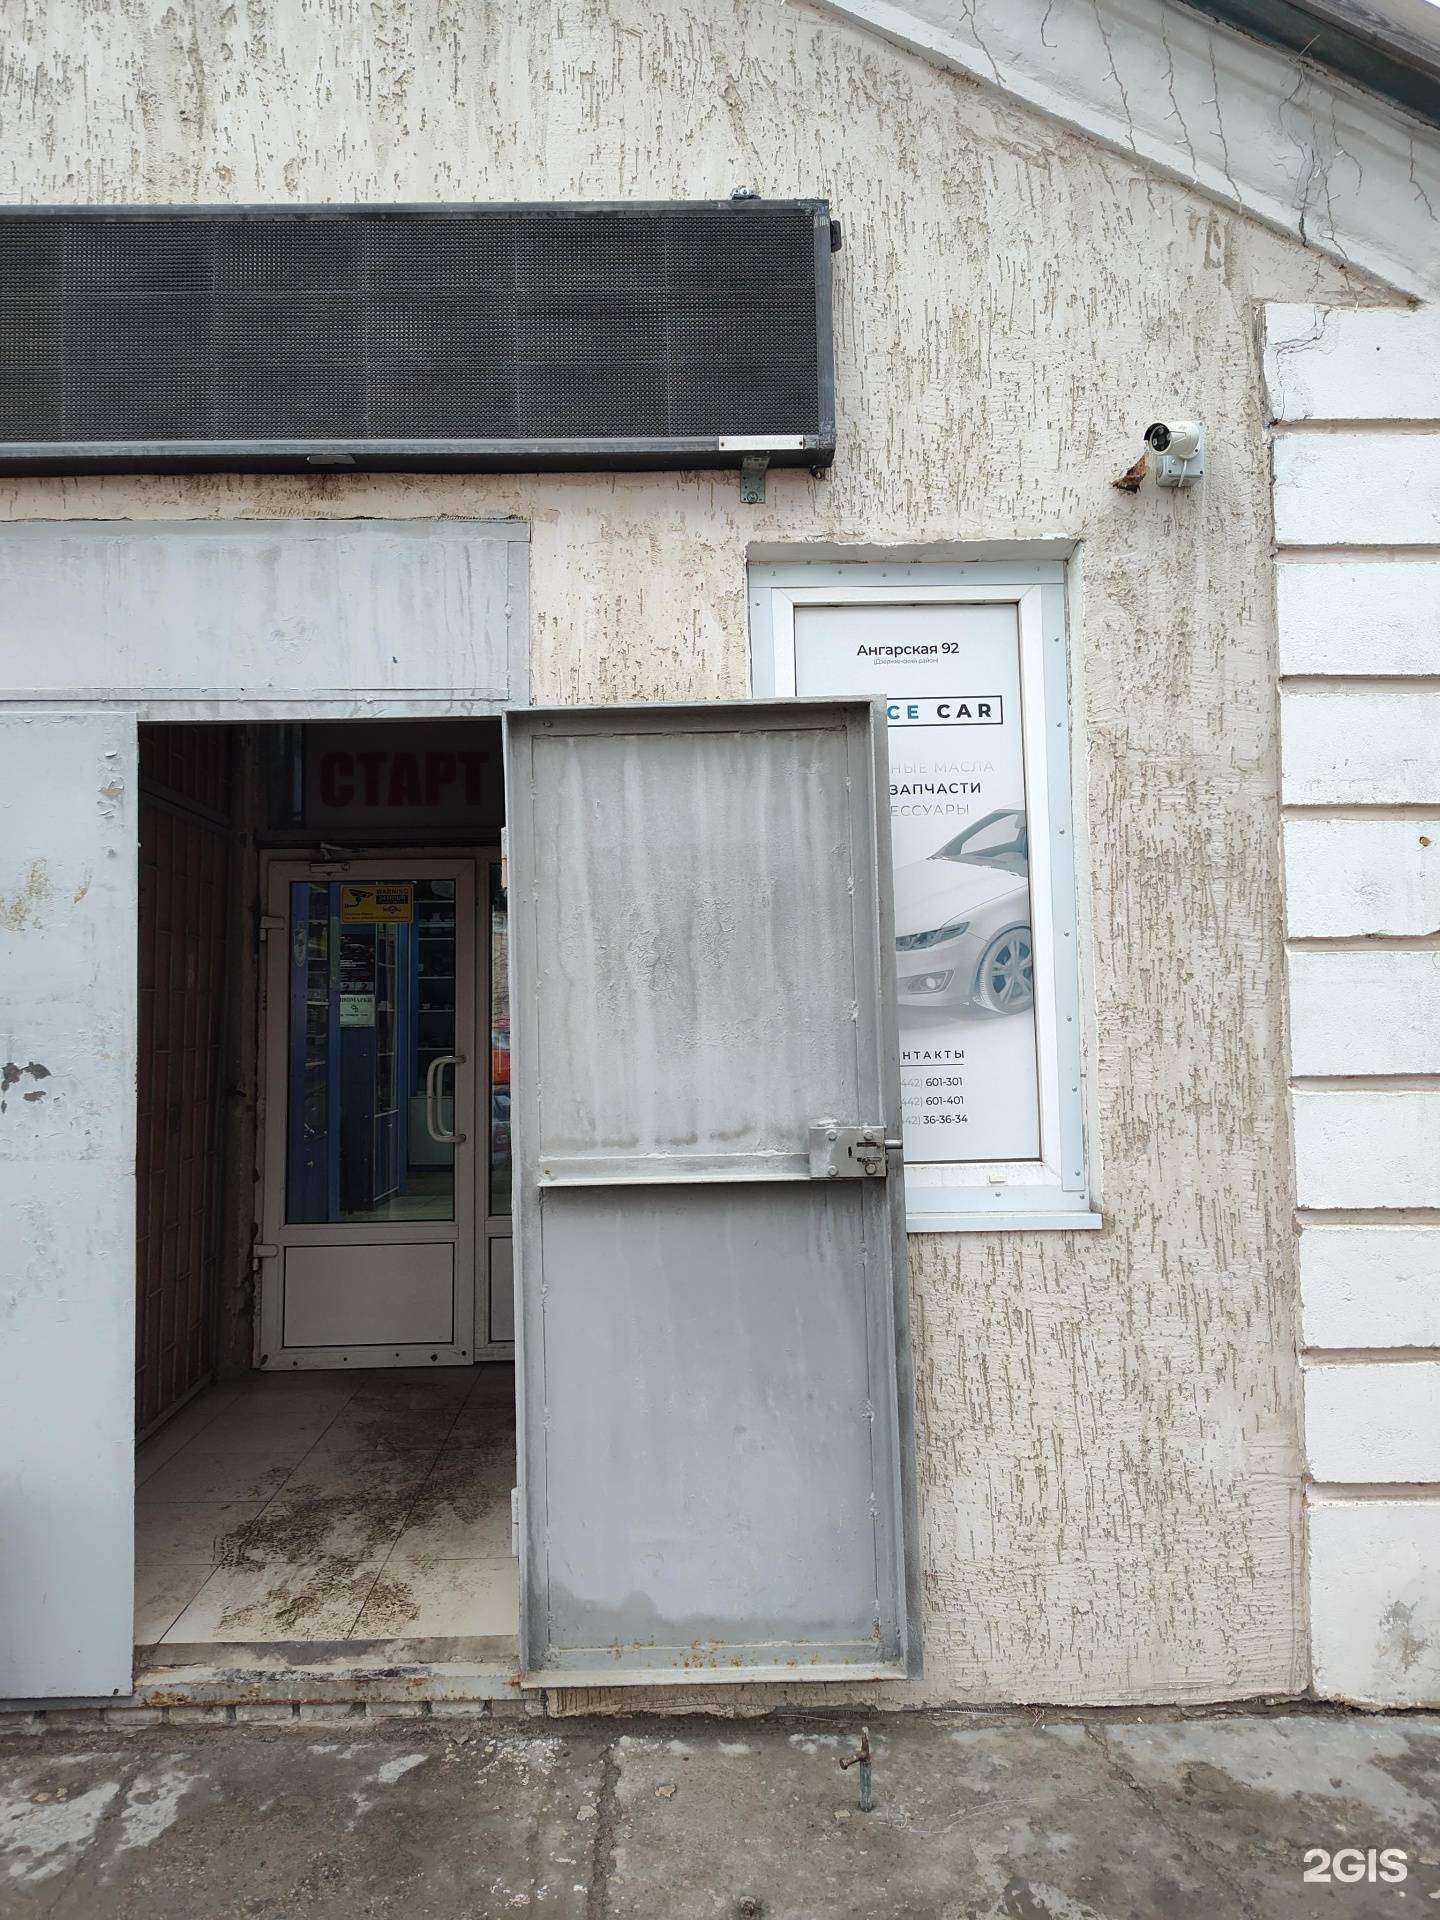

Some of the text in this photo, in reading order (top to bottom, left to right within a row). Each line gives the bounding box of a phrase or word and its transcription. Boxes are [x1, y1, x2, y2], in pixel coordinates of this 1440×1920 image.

[857, 642, 960, 658] Ангарская 92
[936, 703, 992, 719] CAR
[934, 760, 994, 773] МАСЛА
[889, 782, 981, 795] ЗАПЧАСТИ
[890, 803, 969, 817] ЕССУАРЫ
[902, 1050, 965, 1060] НТАКТЫ
[925, 1077, 963, 1087] 601-301
[925, 1096, 964, 1106] 601-401
[923, 1114, 968, 1125] 36-36-34
